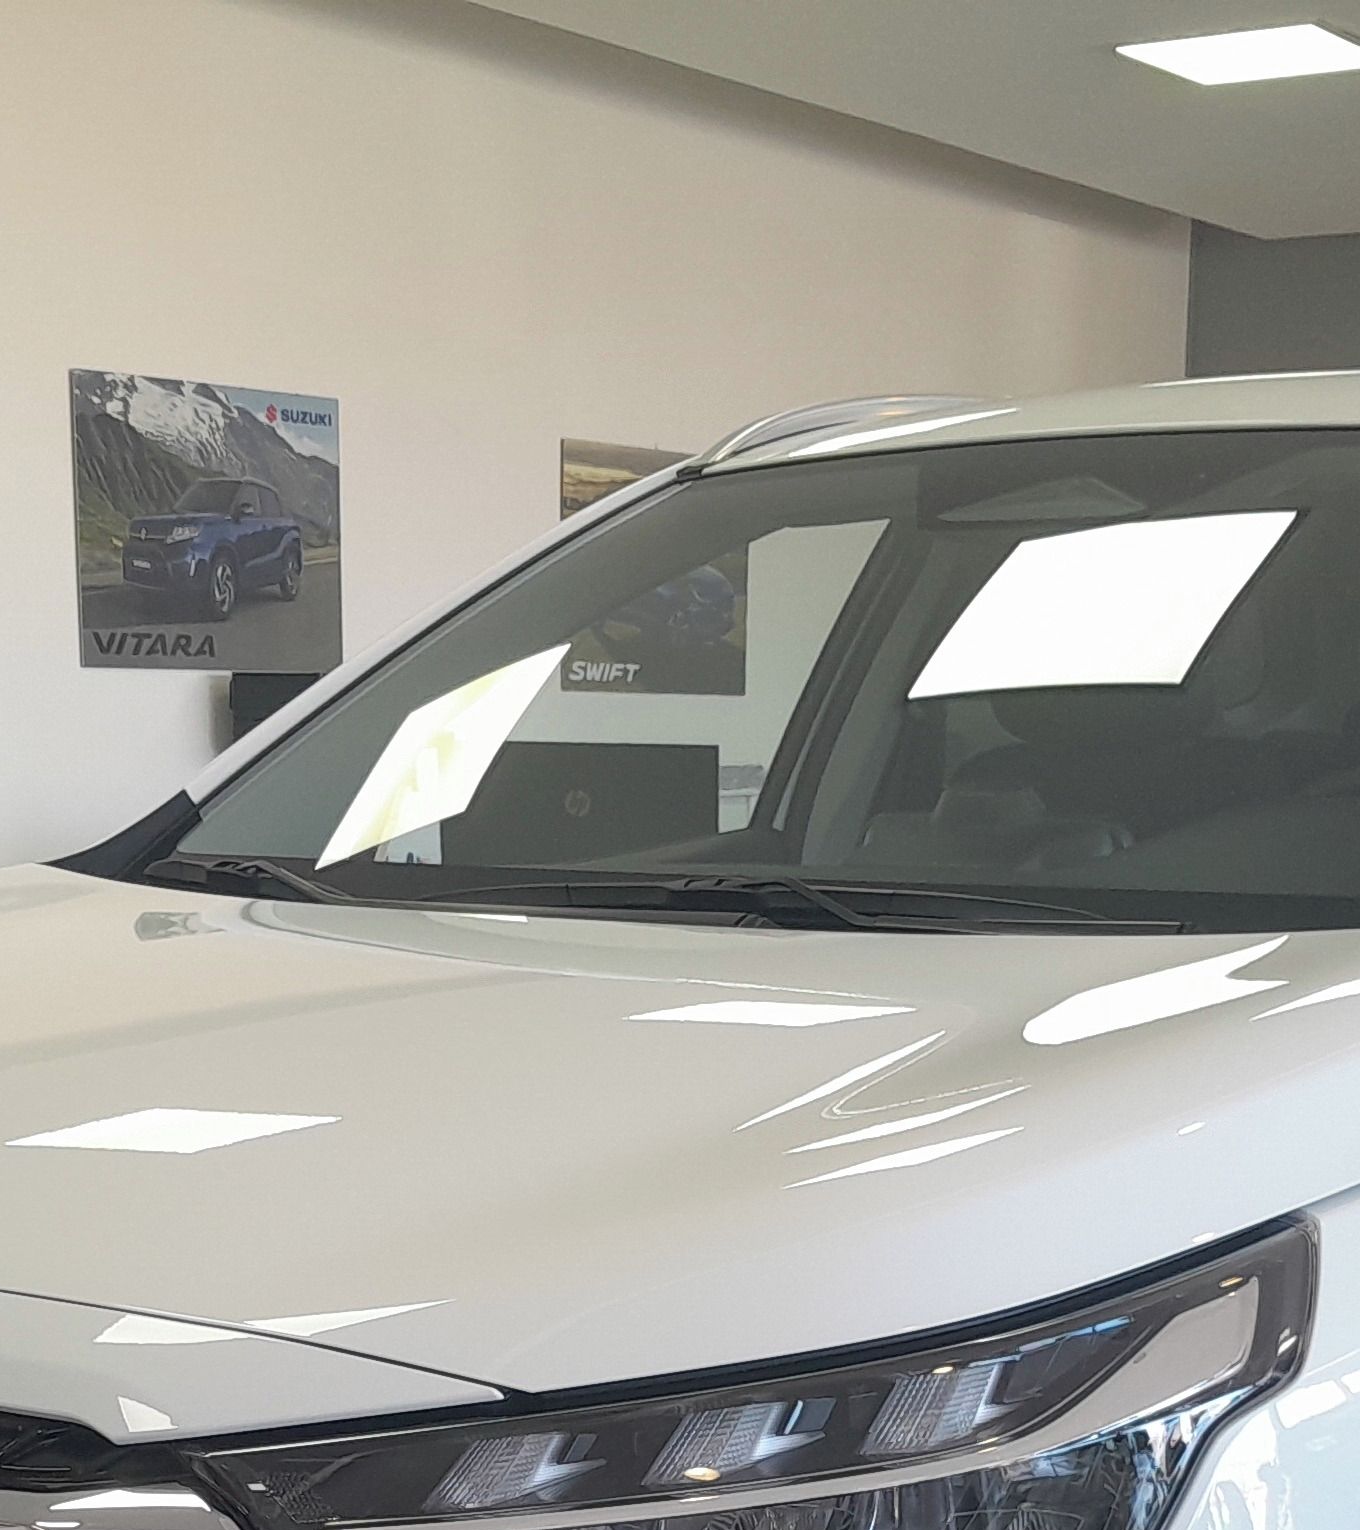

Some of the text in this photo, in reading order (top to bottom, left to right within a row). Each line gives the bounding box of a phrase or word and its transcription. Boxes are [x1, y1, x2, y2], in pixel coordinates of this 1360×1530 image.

[280, 408, 333, 427] SUZUKI
[91, 631, 216, 658] VITARA
[568, 661, 641, 683] SWIFT
